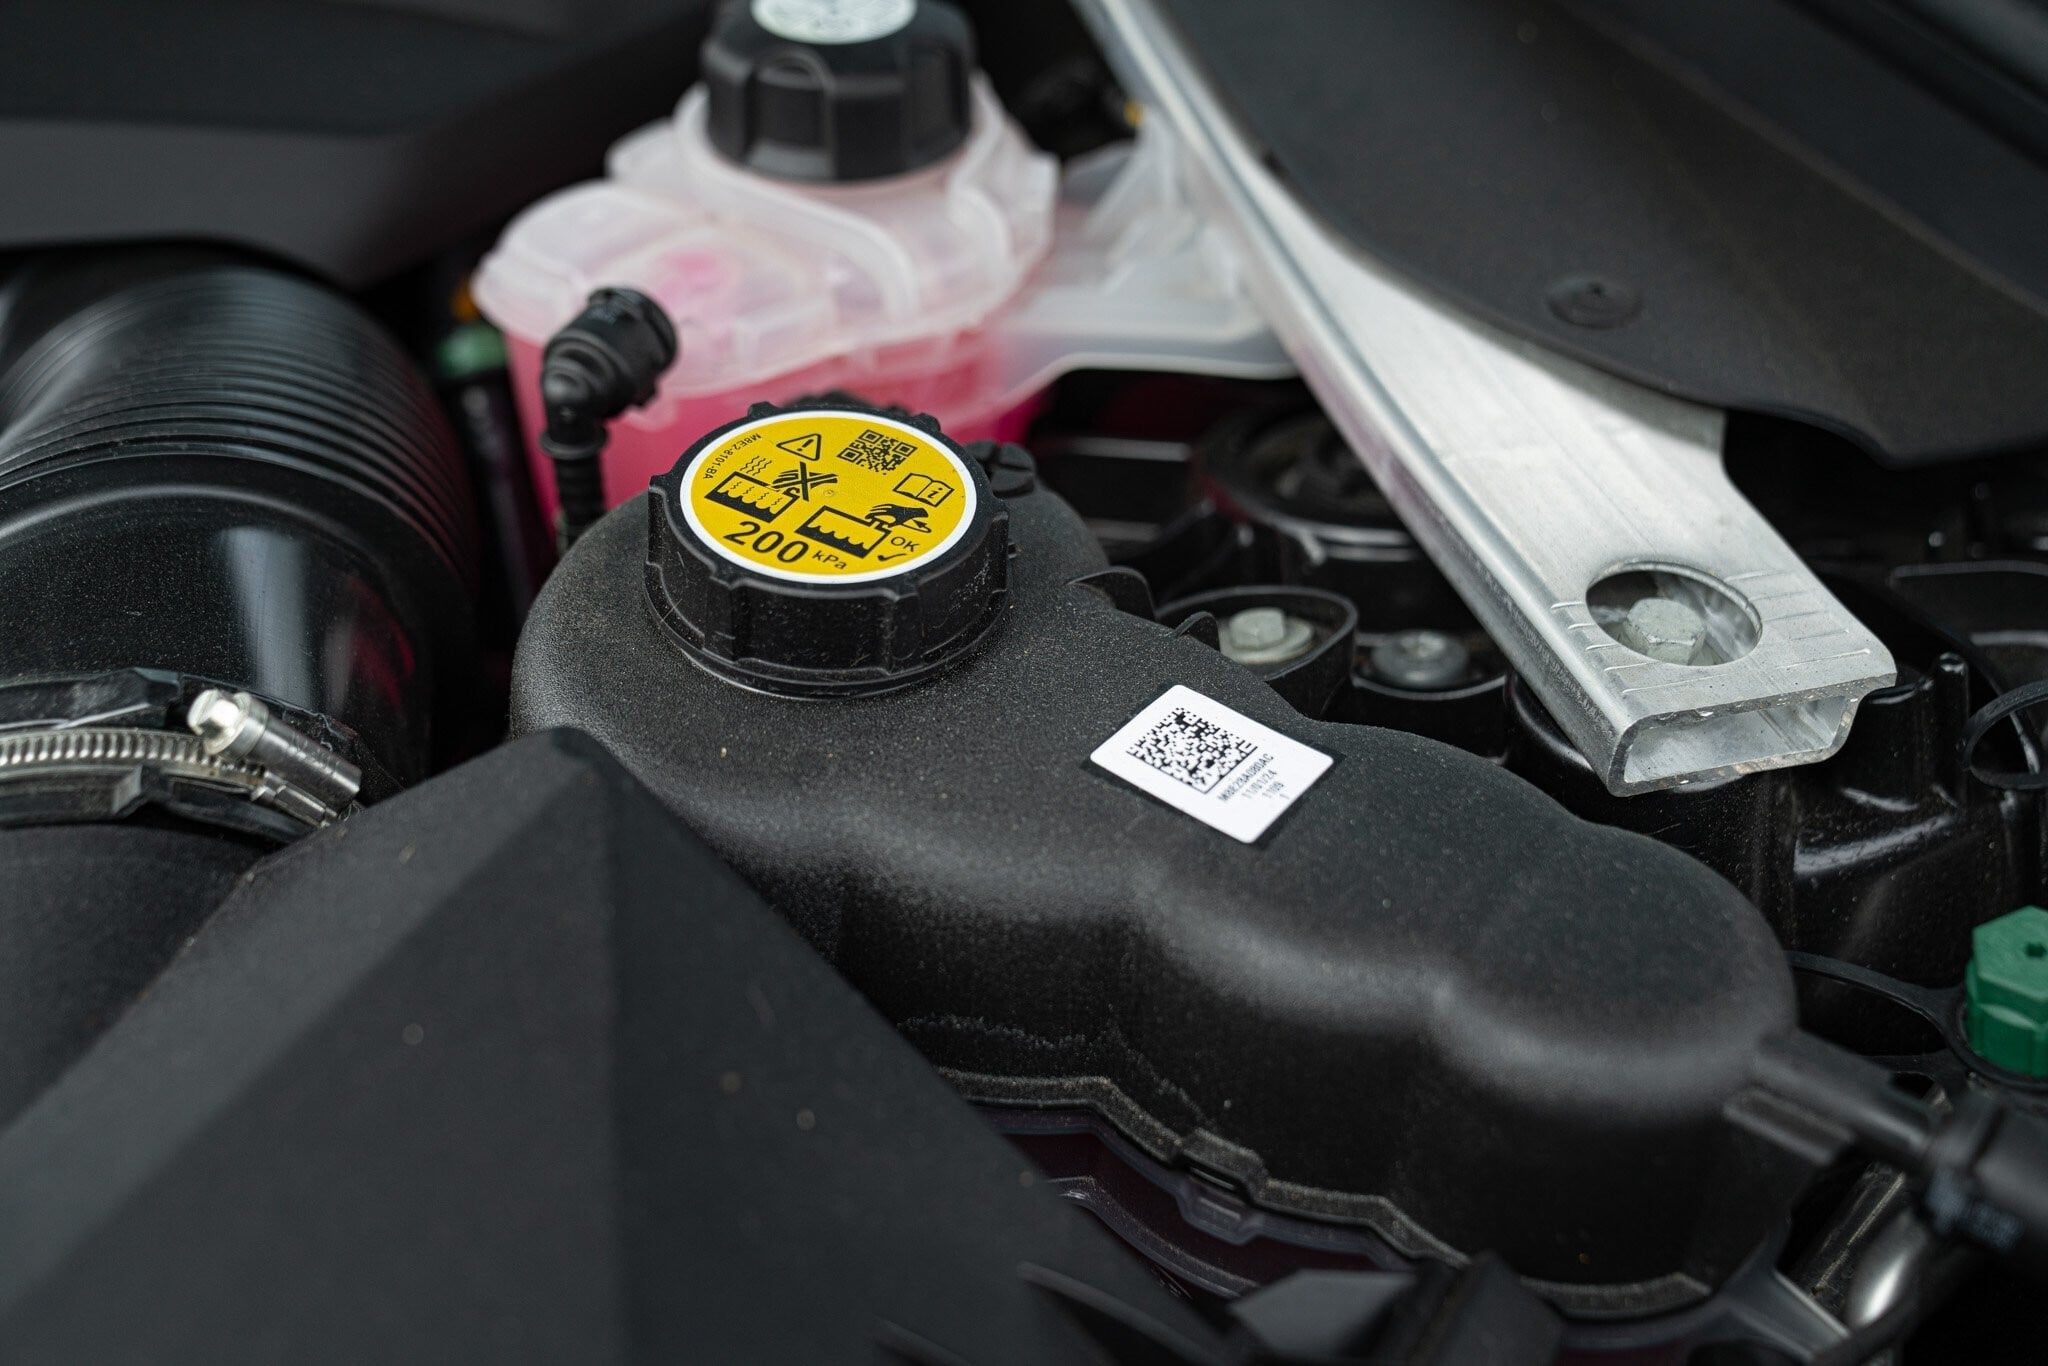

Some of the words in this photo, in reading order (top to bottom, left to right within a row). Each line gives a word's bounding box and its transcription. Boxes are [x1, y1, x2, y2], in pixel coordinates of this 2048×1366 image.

[723, 520, 809, 563] 200
[812, 552, 848, 570] kPa
[890, 536, 920, 553] OK
